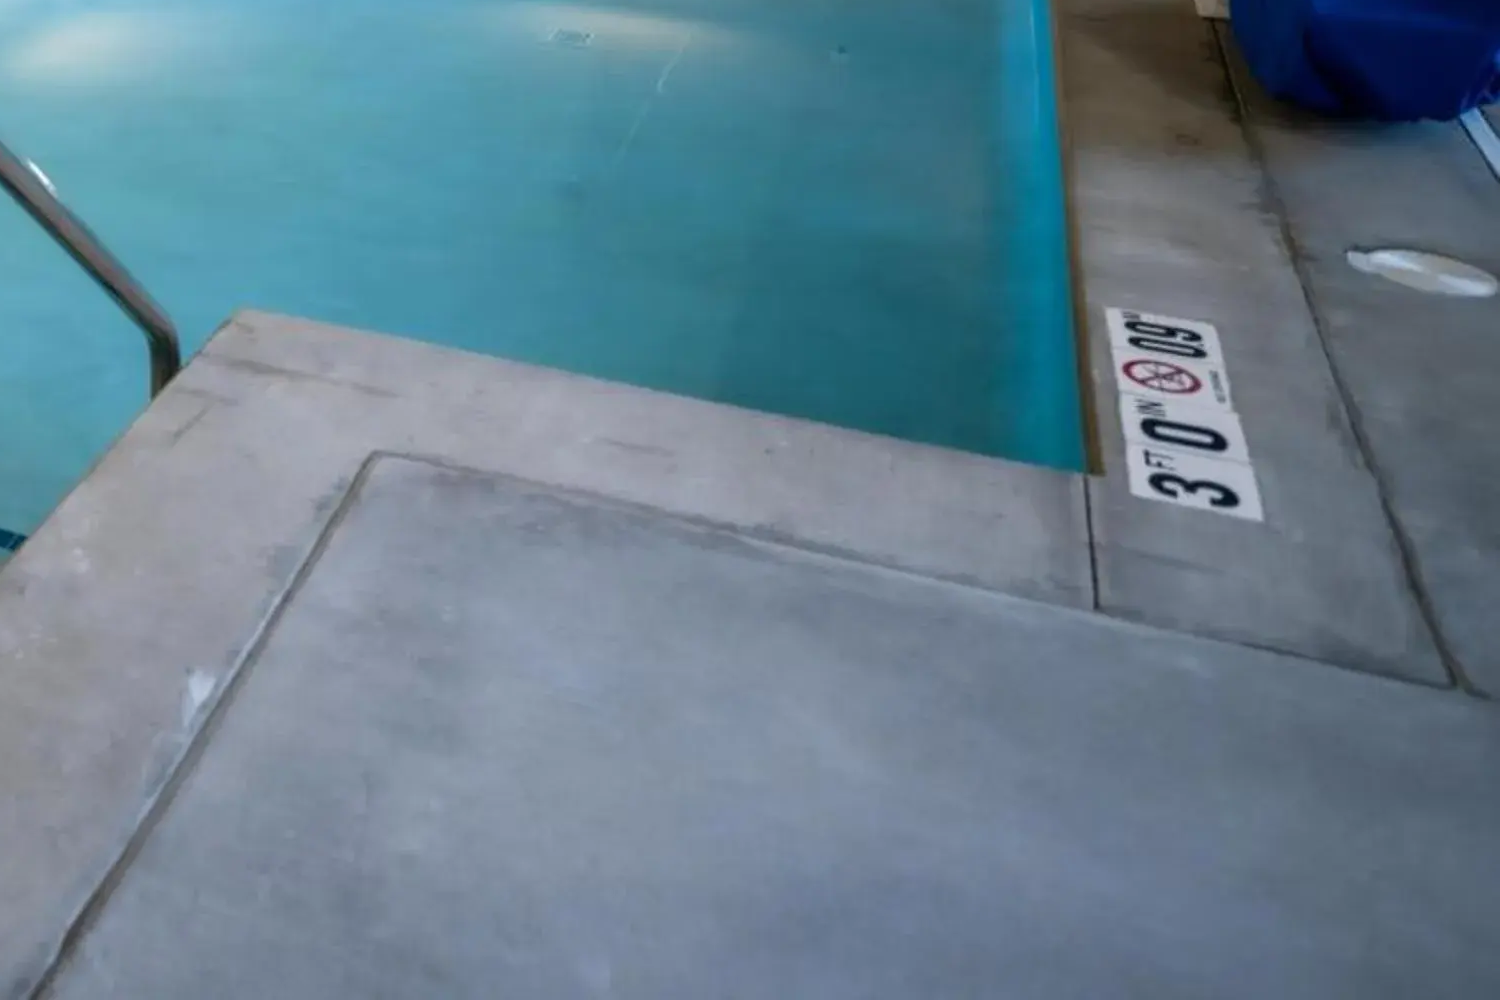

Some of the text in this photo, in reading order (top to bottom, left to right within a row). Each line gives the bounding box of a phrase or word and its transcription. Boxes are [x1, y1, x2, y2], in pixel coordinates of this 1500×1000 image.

[1139, 417, 1230, 454] 0
[1142, 449, 1177, 472] FT
[1147, 472, 1241, 510] 3
